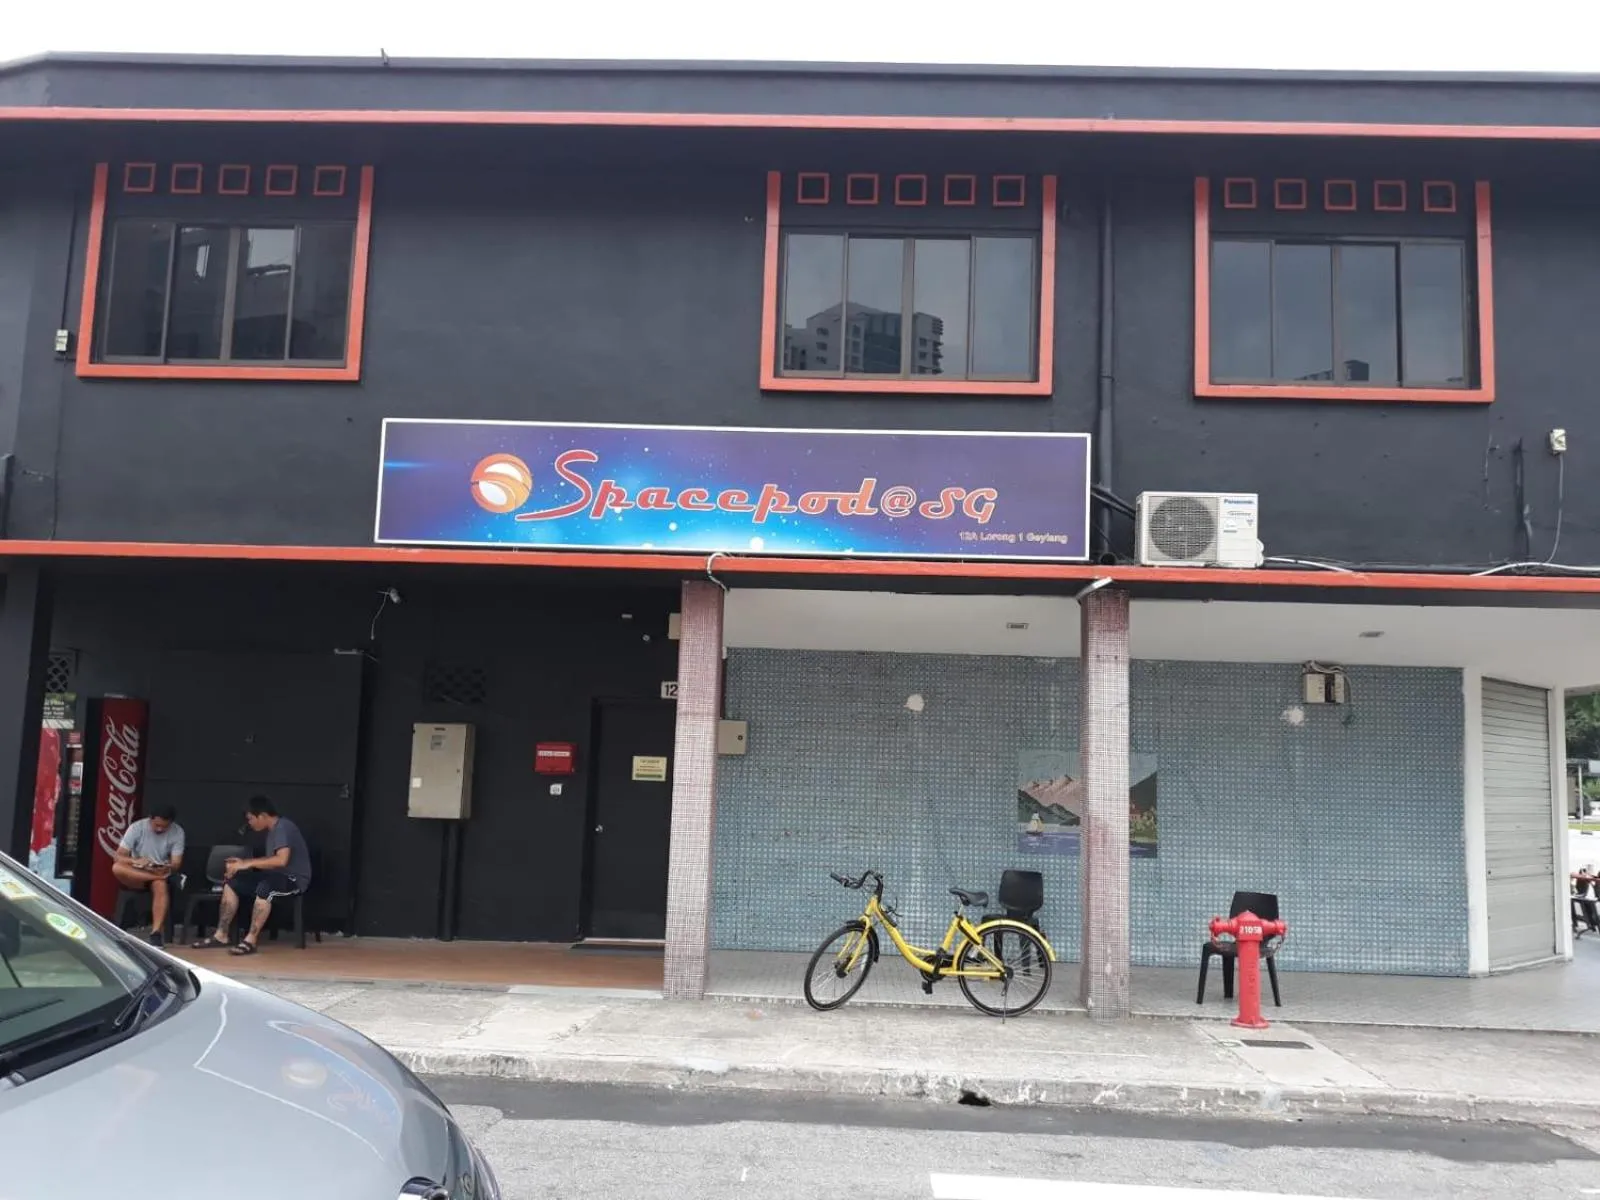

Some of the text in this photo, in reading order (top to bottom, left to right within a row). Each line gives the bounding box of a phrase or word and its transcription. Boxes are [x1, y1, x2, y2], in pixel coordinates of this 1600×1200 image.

[515, 449, 998, 524] Spacepod@SG
[980, 532, 1016, 544] Lorong
[1026, 533, 1068, 544] Geylang
[664, 684, 679, 697] 12
